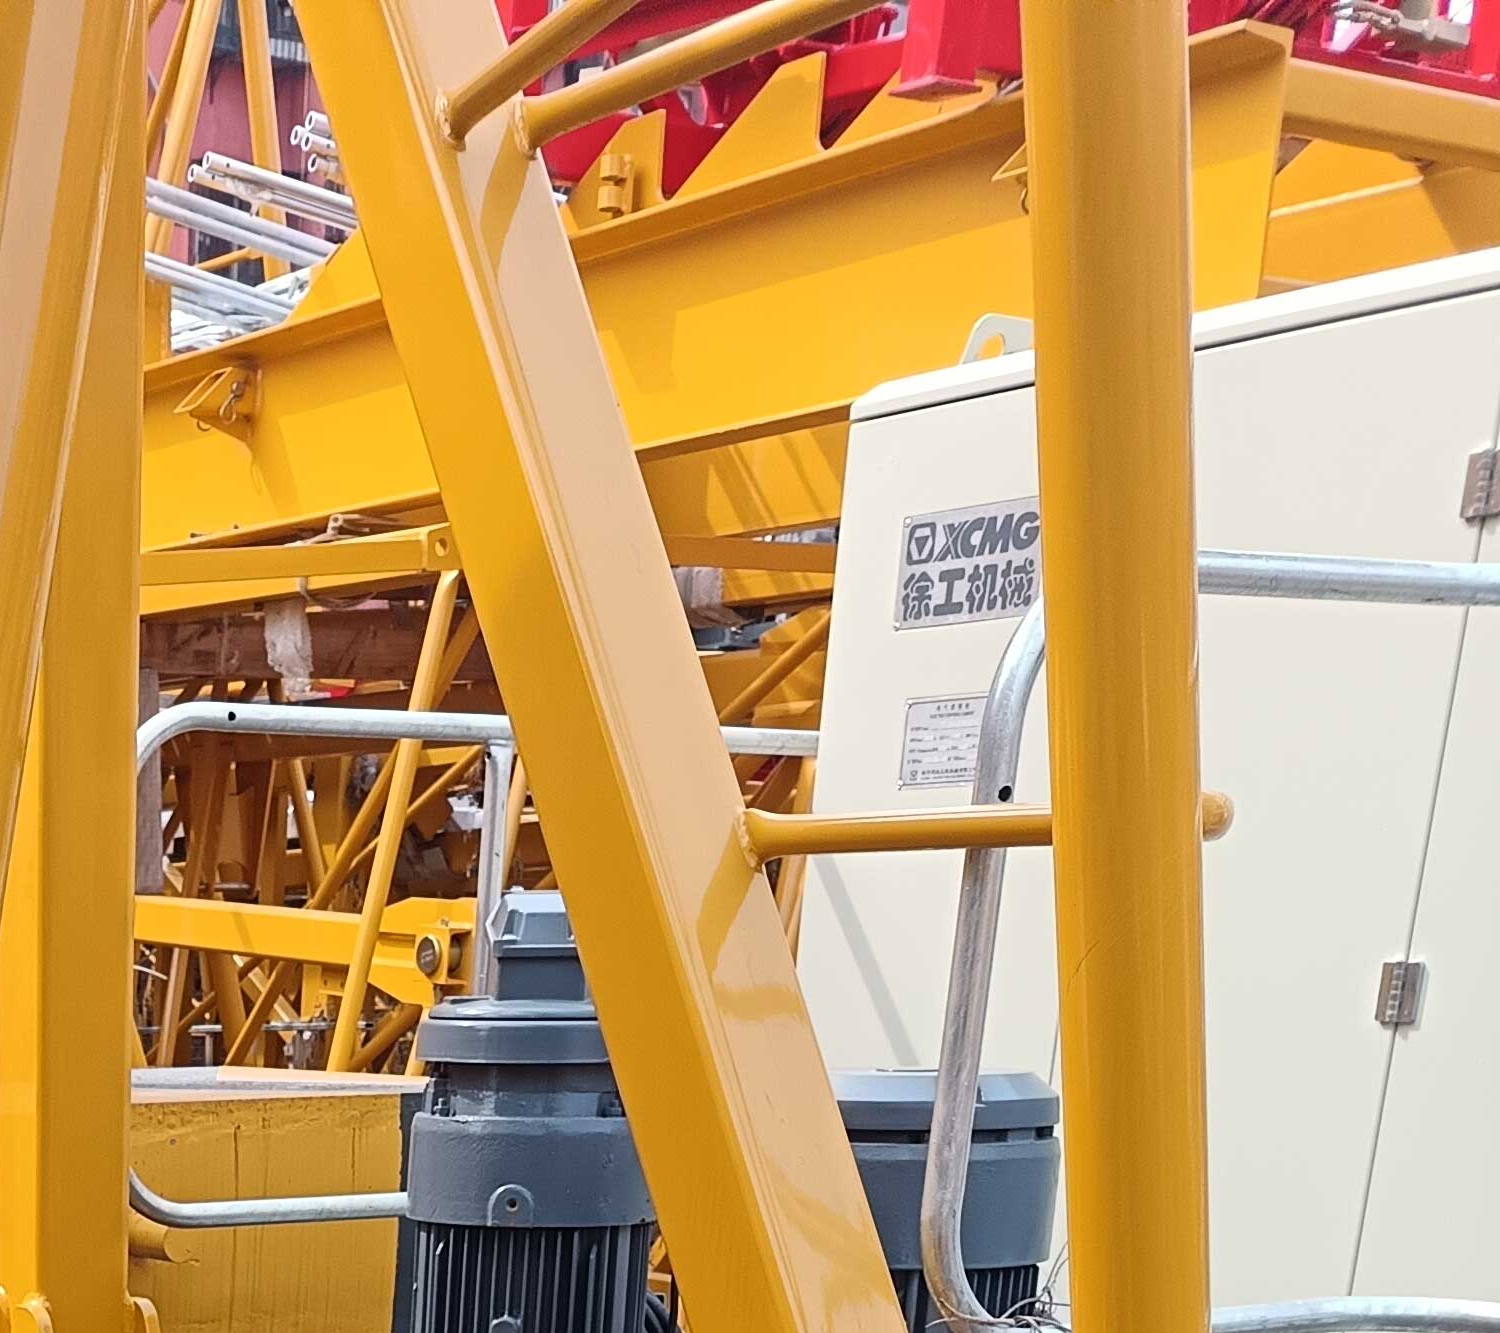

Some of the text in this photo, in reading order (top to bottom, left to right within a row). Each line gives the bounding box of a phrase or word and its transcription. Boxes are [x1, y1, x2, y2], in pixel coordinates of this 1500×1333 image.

[932, 511, 1040, 562] XCMG
[902, 557, 1035, 621] 徐工机械
